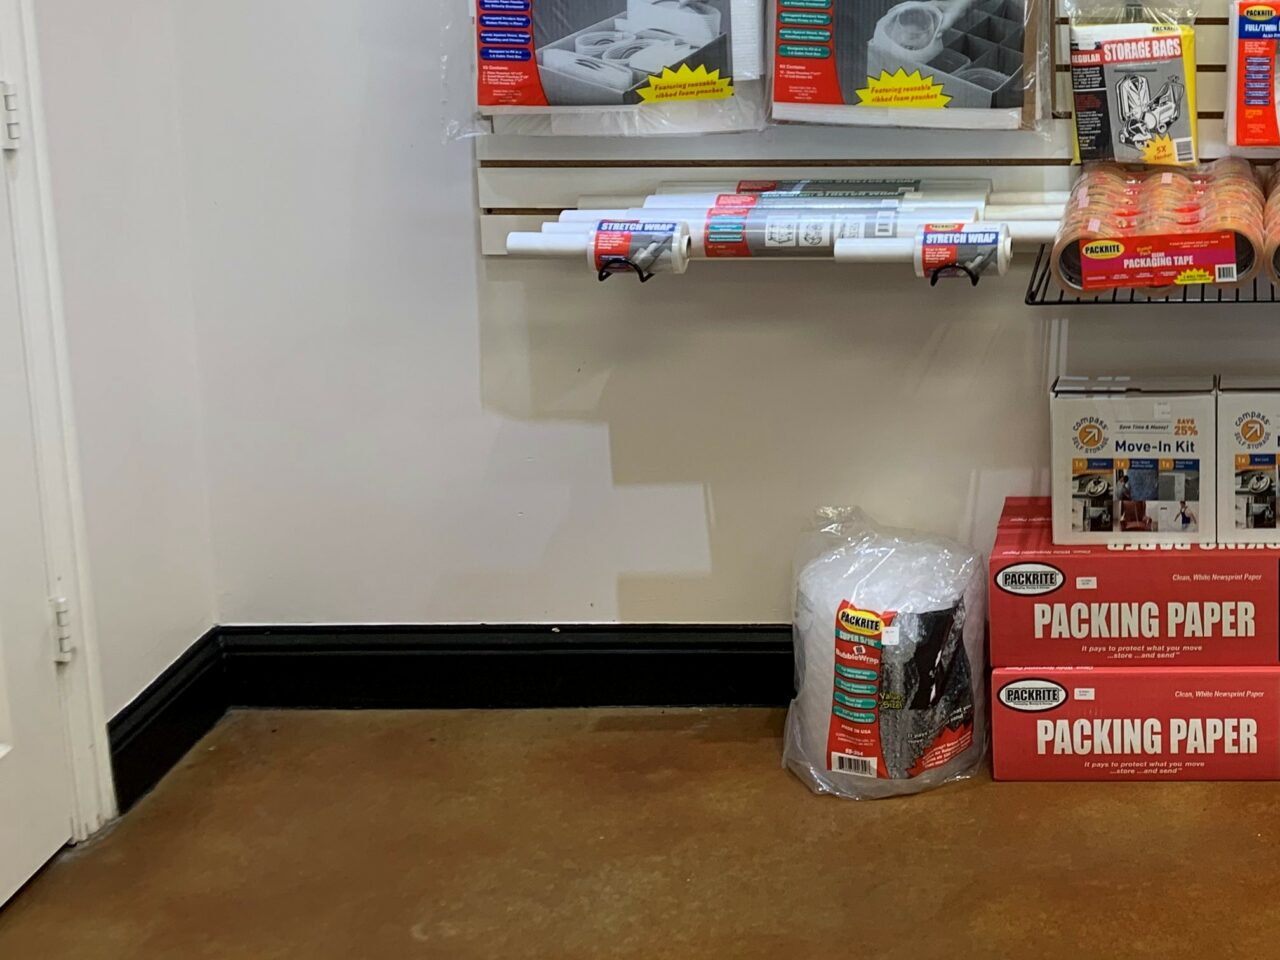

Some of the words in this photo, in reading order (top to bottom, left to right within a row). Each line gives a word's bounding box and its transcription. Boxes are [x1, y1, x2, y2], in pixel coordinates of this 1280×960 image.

[1246, 9, 1273, 17] PACKRITE
[1245, 24, 1277, 32] FULL/TWIN
[1104, 42, 1151, 61] STORAGE
[1153, 39, 1181, 58] BAGS
[926, 233, 966, 244] STRETCH
[968, 233, 996, 243] WRAP
[1085, 244, 1120, 254] PACKRITE
[1124, 256, 1172, 269] PACKAGING
[1174, 255, 1194, 265] TAPE
[1174, 425, 1198, 436] 25%
[1115, 440, 1171, 453] Move-In
[1176, 440, 1195, 453] Kit
[1004, 572, 1056, 586] PACKRITE
[1211, 574, 1242, 582] Newsprint
[1244, 574, 1262, 582] Paper
[841, 611, 880, 631] PACKRITE
[1034, 602, 1159, 639] PACKING
[1167, 601, 1255, 638] PAPER
[1088, 645, 1106, 653] pays
[1165, 645, 1181, 653] you
[1006, 688, 1059, 702] PACKRITE
[1036, 718, 1162, 755] PACKING
[1169, 717, 1258, 755] PAPER
